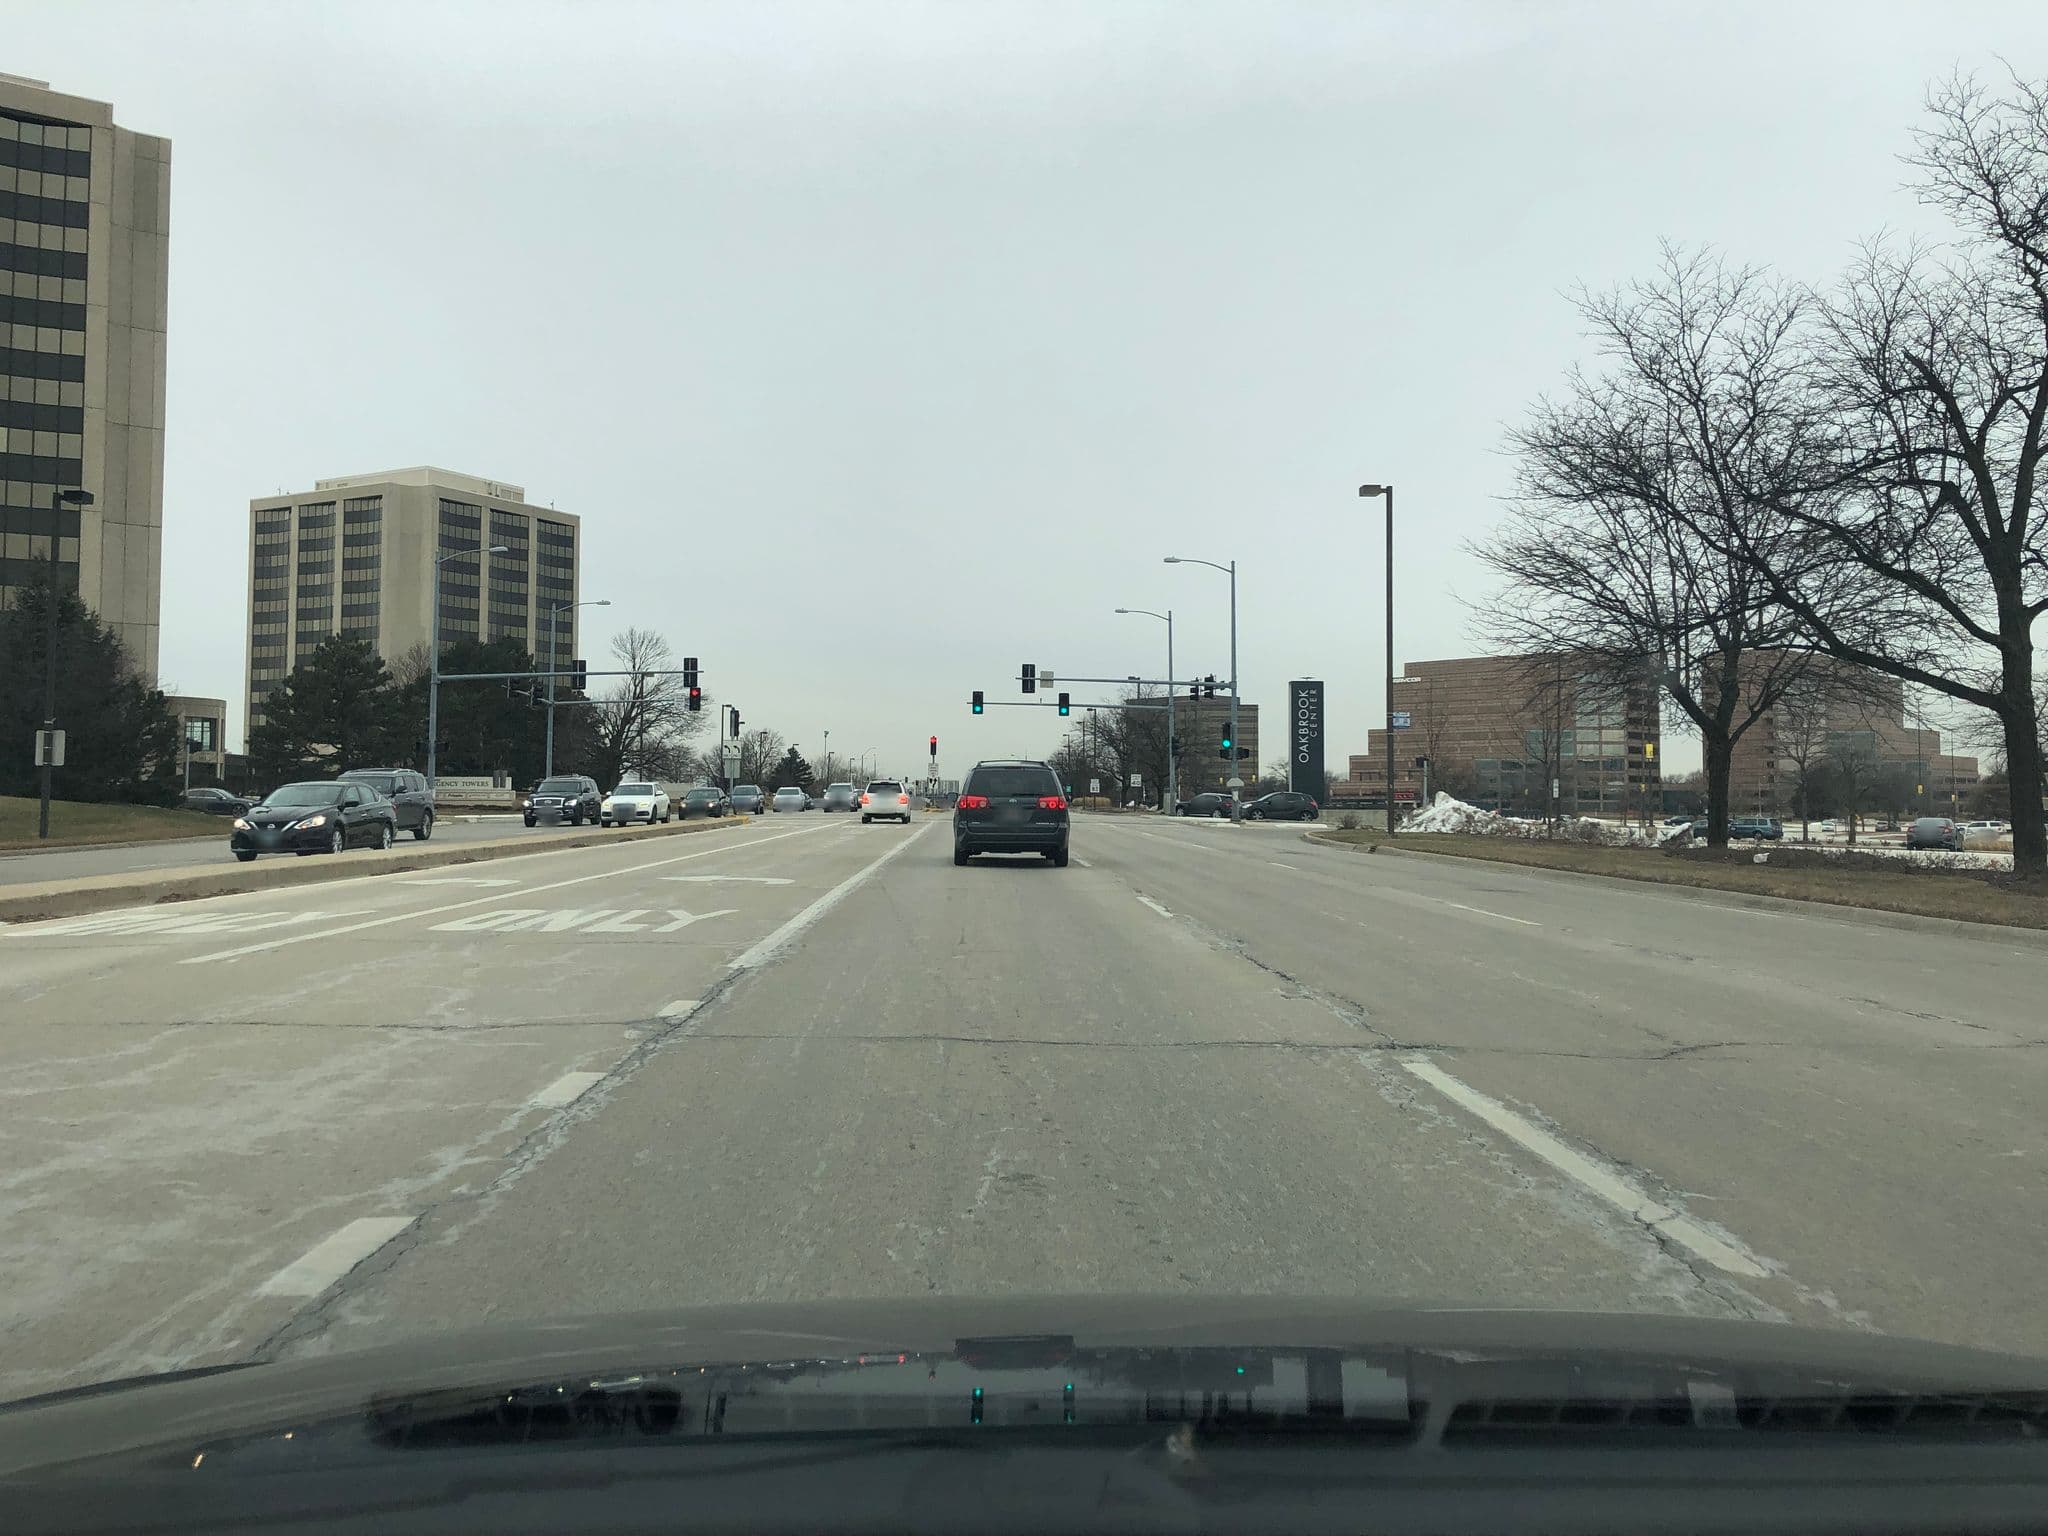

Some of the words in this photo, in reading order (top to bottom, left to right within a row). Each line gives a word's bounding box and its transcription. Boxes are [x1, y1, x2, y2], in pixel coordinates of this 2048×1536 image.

[1298, 689, 1309, 763] OAKBROOK
[1309, 689, 1318, 738] CENTER
[427, 909, 741, 932] ONLY
